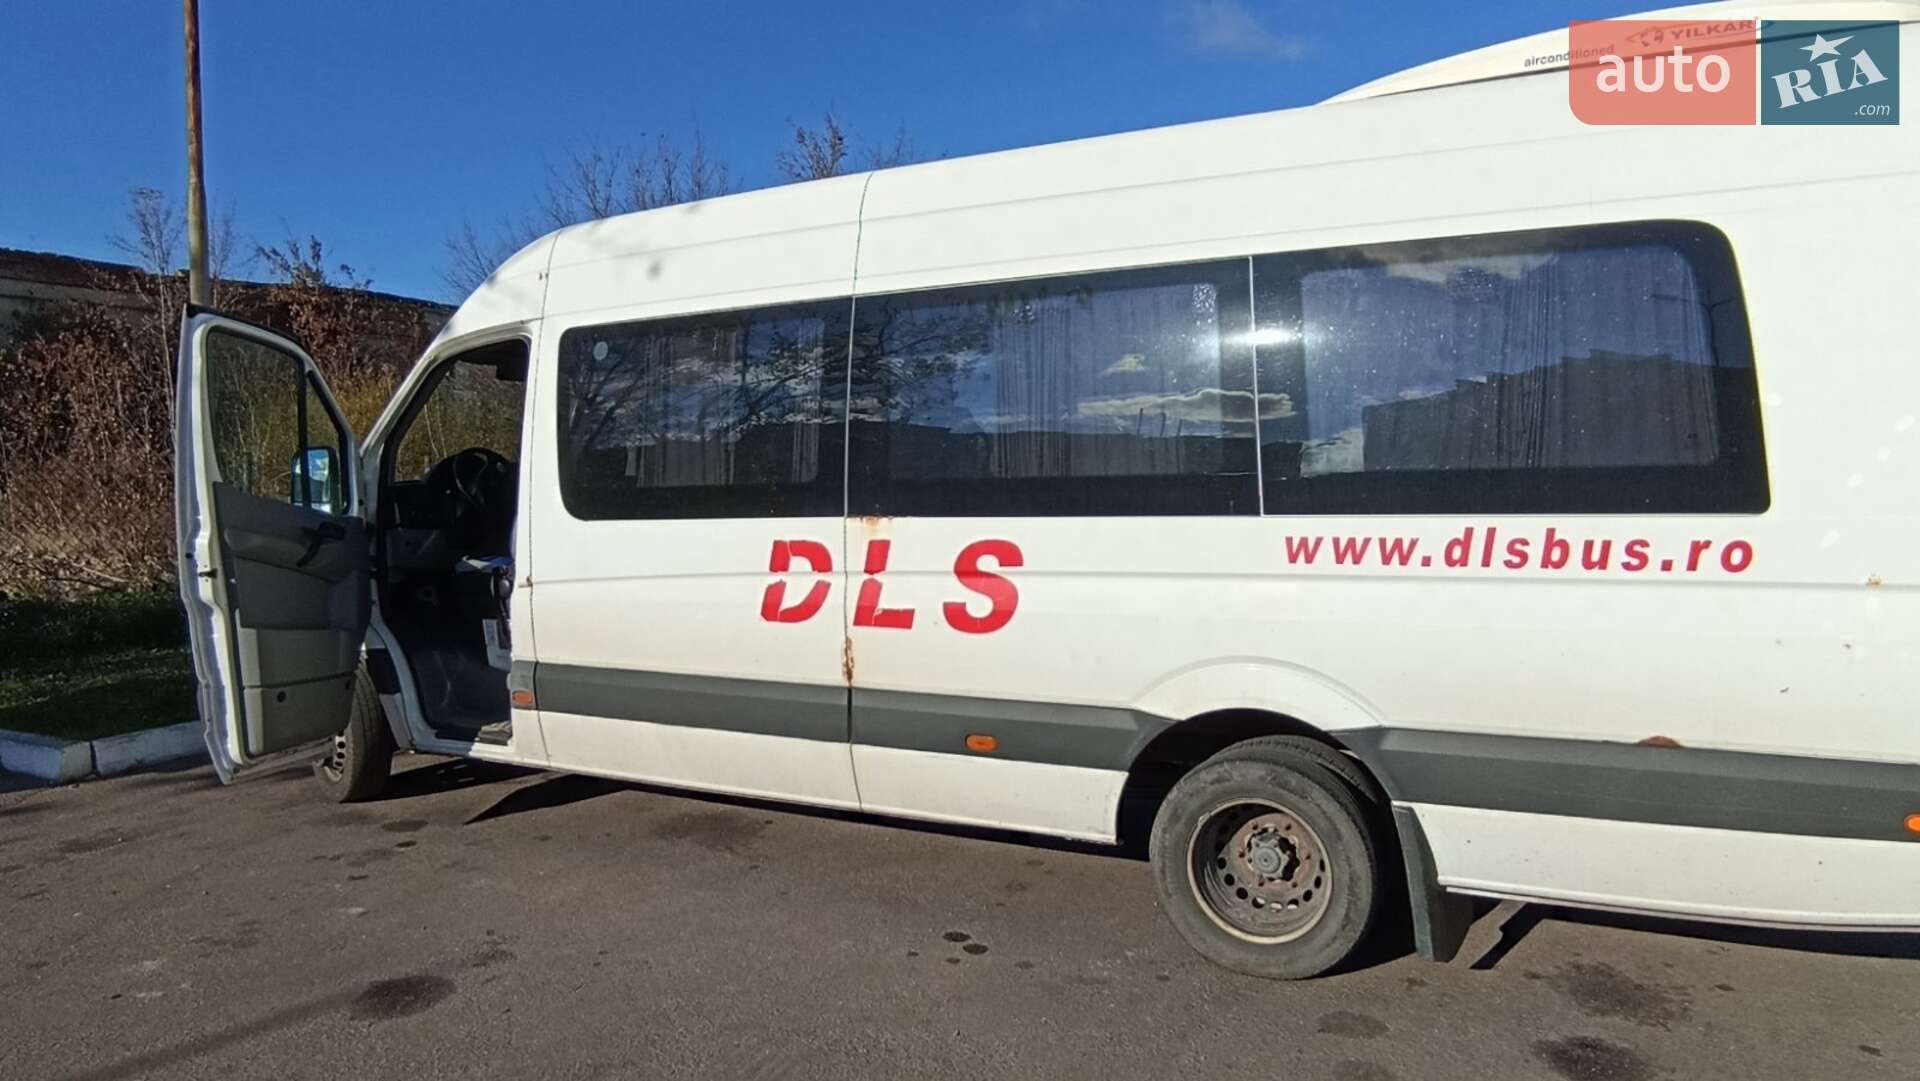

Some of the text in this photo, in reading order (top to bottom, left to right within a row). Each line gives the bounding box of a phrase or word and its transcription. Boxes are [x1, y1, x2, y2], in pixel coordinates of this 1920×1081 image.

[1671, 19, 1753, 39] YILKAR
[1524, 44, 1615, 67] airconditioned
[1284, 527, 1754, 573] www.dlsbus.ro
[760, 539, 1024, 634] DLS
